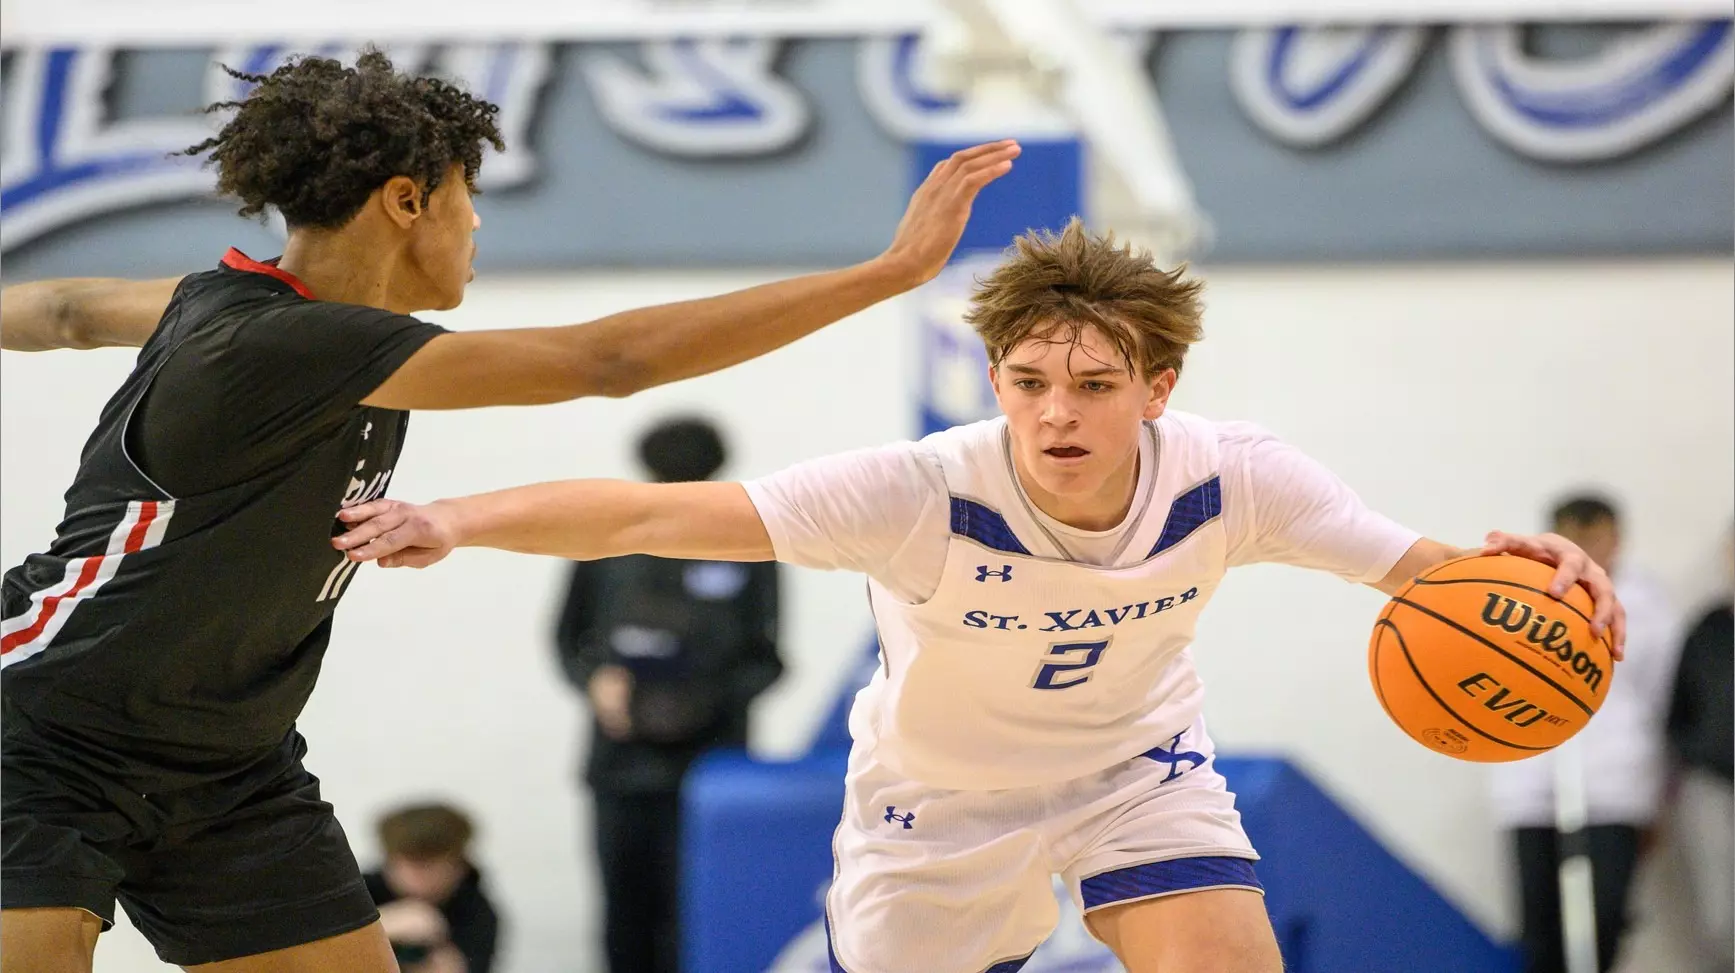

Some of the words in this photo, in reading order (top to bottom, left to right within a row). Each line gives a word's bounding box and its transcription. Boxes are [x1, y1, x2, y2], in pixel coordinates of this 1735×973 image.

[962, 610, 1028, 631] ST.
[1038, 586, 1200, 632] XAVIER
[1029, 635, 1114, 690] 2
[1480, 591, 1604, 694] Wilson
[1456, 671, 1548, 728] EVO
